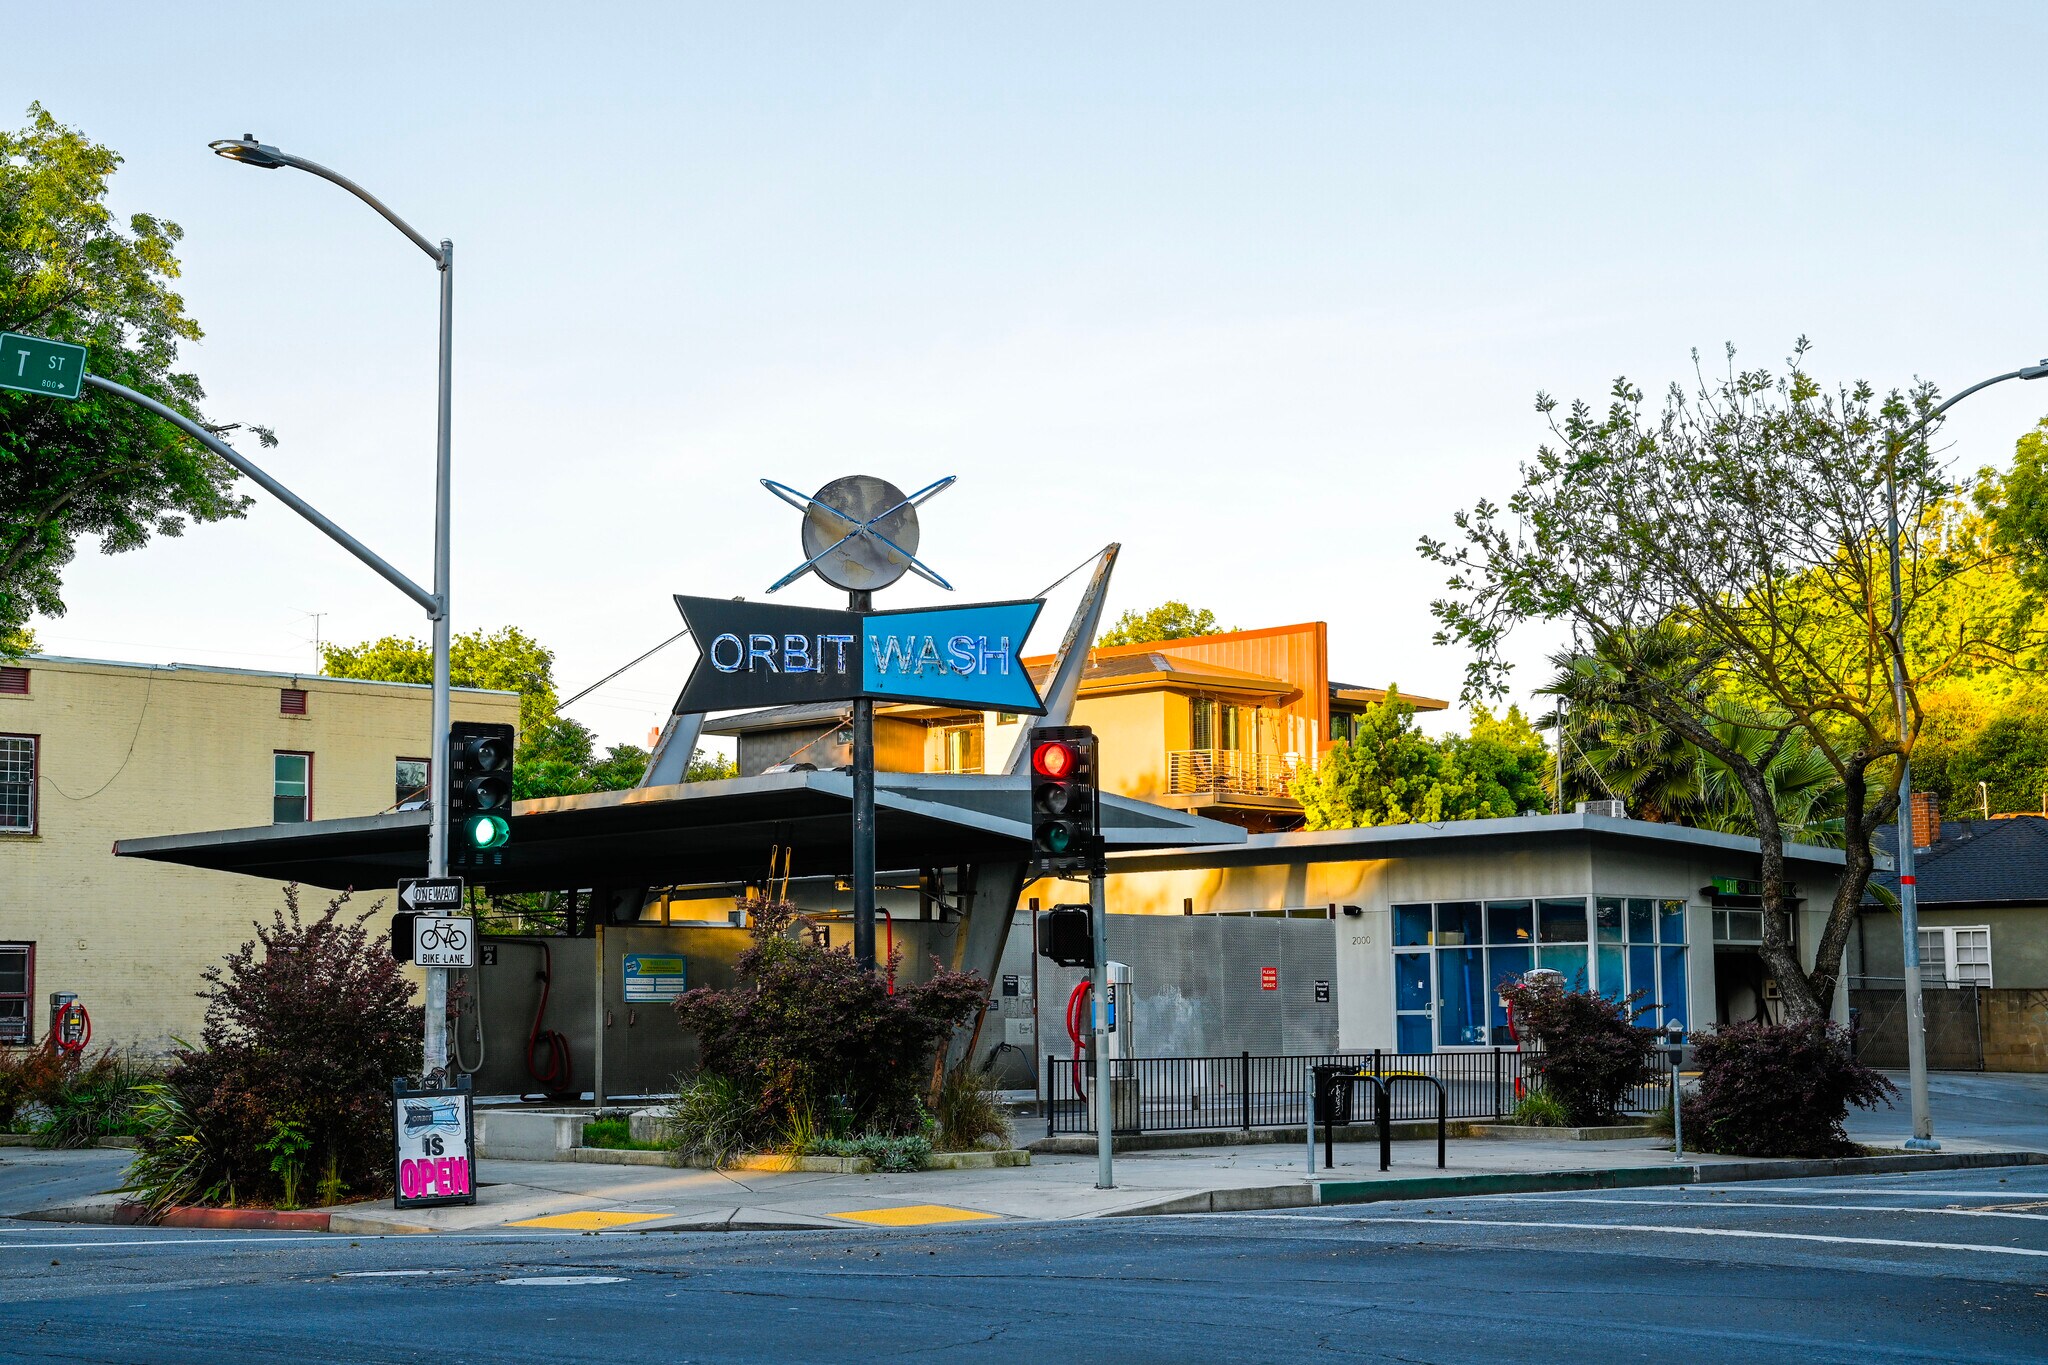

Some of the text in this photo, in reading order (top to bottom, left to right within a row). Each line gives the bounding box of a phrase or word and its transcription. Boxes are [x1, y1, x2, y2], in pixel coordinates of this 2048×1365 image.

[17, 349, 66, 377] T ST
[41, 379, 57, 389] 800
[710, 633, 1010, 676] ORBIT WASH
[415, 886, 457, 902] ONE WAY
[1726, 879, 1738, 894] EXIT
[1352, 936, 1371, 945] 2000
[422, 953, 465, 964] BIKE LANE
[484, 952, 493, 965] 2
[423, 1134, 445, 1156] IS
[401, 1157, 470, 1199] OPEN
